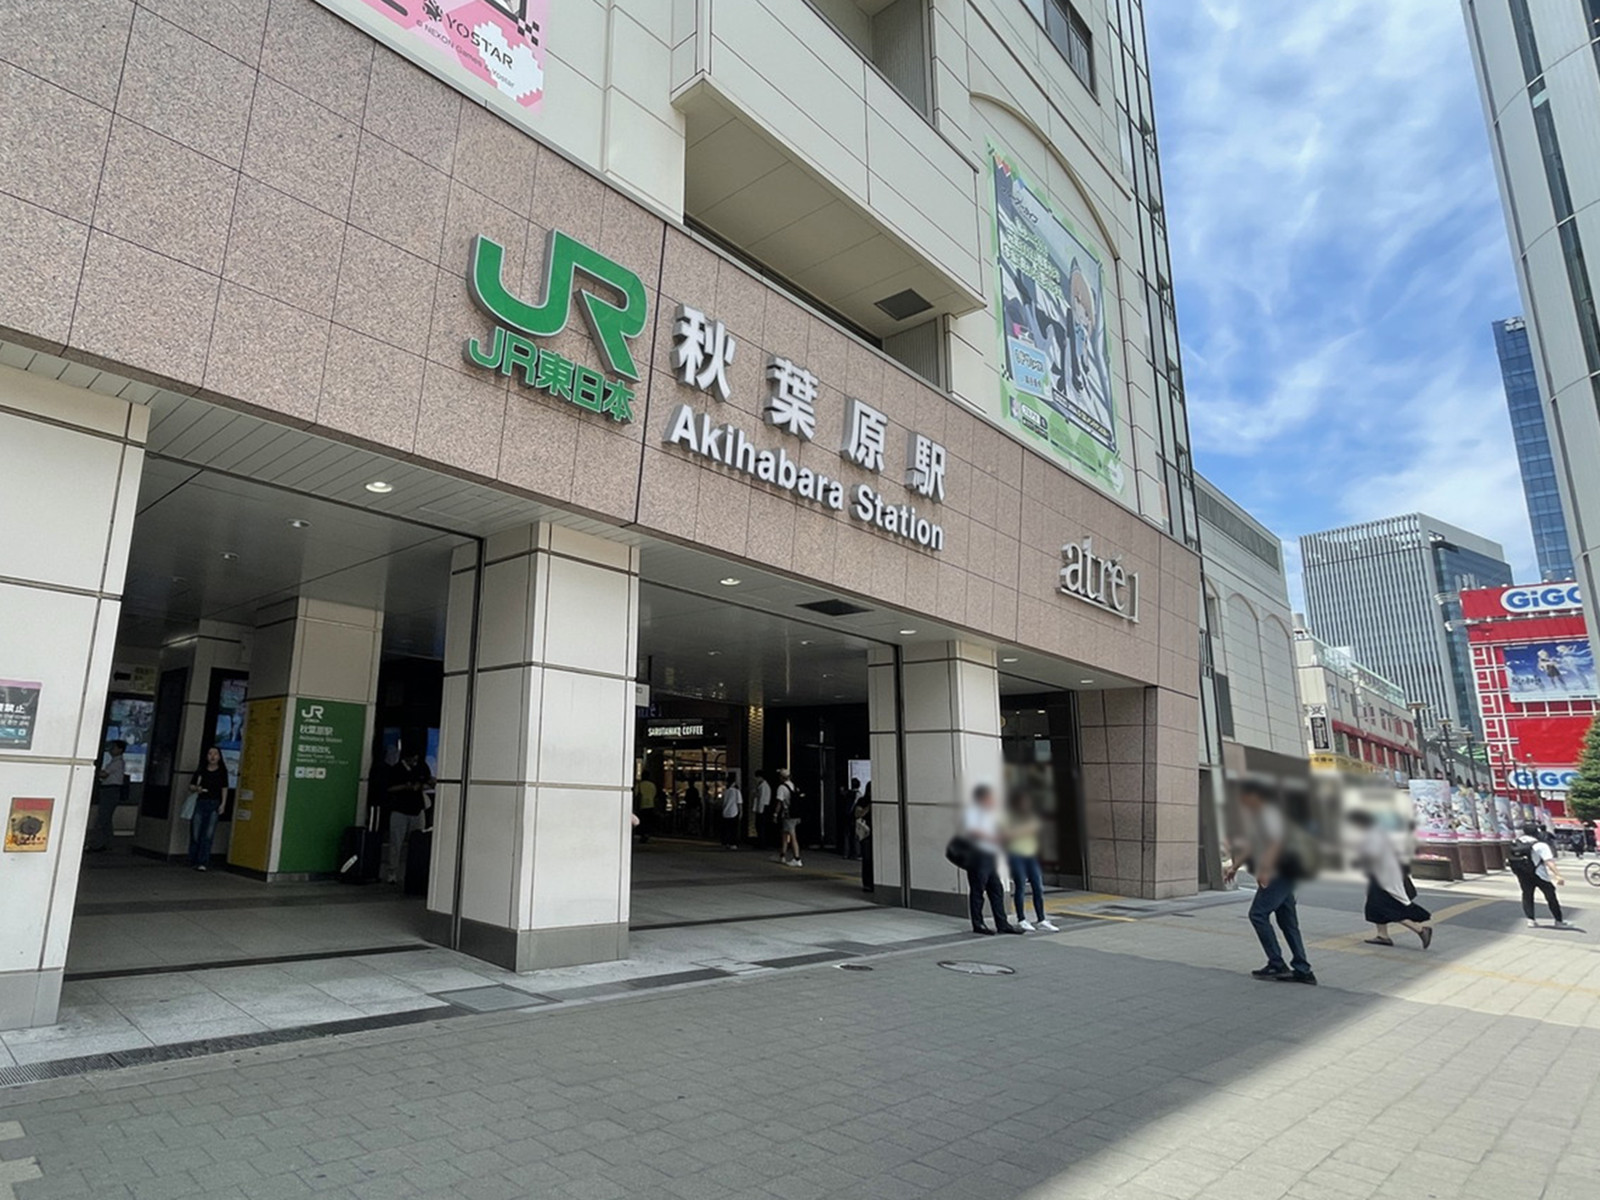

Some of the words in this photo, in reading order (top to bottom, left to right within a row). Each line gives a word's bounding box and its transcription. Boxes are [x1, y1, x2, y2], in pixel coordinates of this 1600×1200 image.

[424, 24, 455, 49] NEXON
[446, 13, 515, 70] YOSTAR
[468, 228, 649, 383] JR
[464, 326, 636, 424] JR東日本
[670, 302, 947, 501] 秋葉原駅
[663, 404, 845, 511] Akihabara
[851, 484, 944, 551] Station
[301, 705, 324, 719] JR
[682, 725, 704, 735] COFFEE
